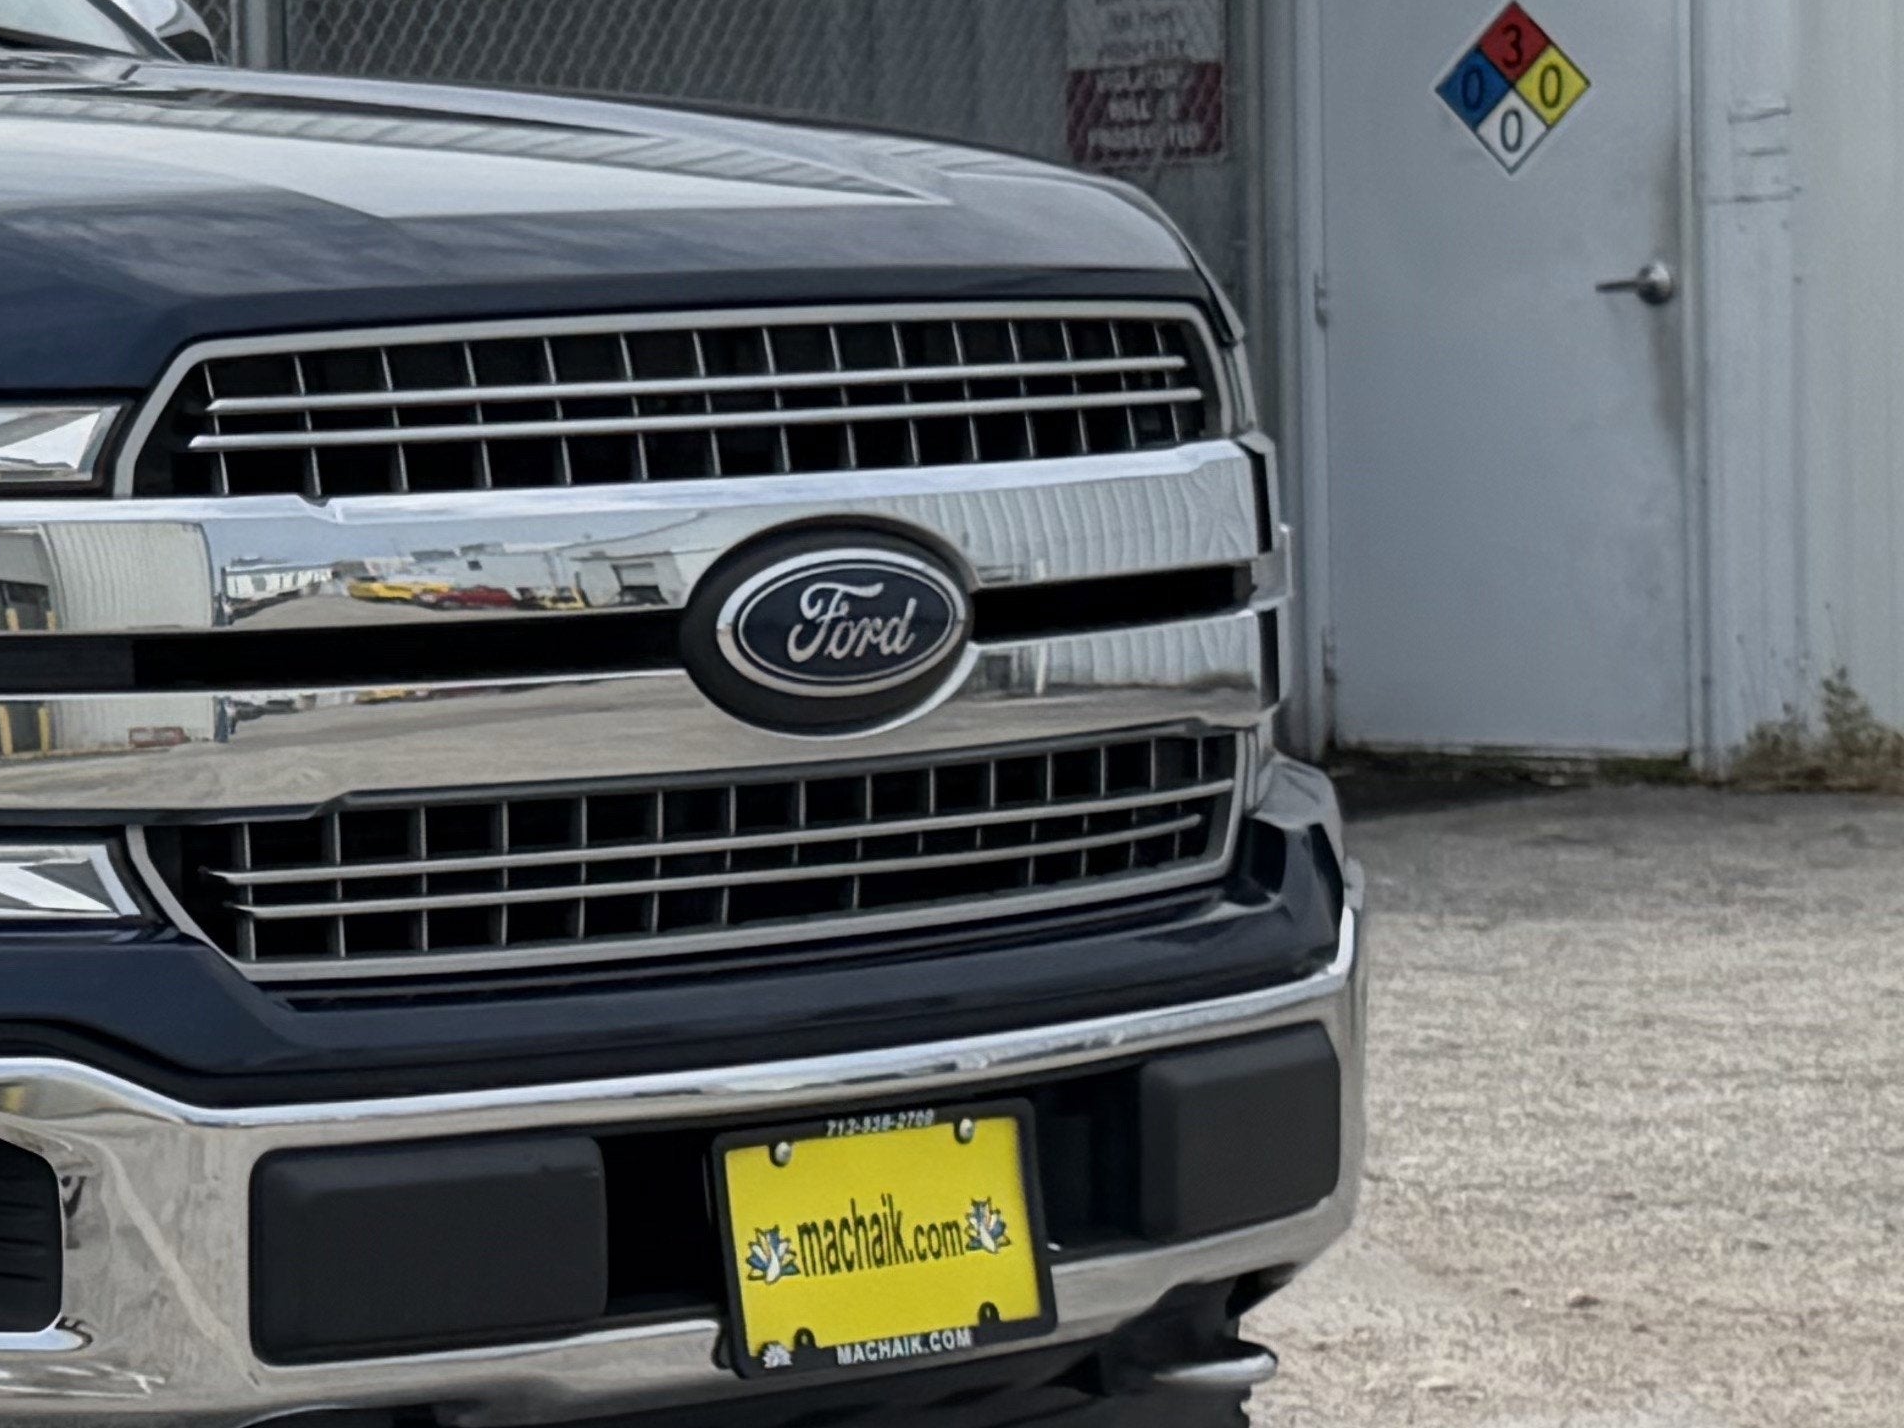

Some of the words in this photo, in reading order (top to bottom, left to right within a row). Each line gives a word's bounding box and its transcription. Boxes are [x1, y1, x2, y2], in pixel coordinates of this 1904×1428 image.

[1502, 23, 1523, 69] 3
[1461, 64, 1484, 110] 0
[1539, 64, 1562, 109] 0
[1500, 108, 1523, 154] 0
[787, 581, 918, 663] Ford
[796, 1192, 965, 1278] machaik.com
[835, 1328, 973, 1366] MACHAIK.COM
